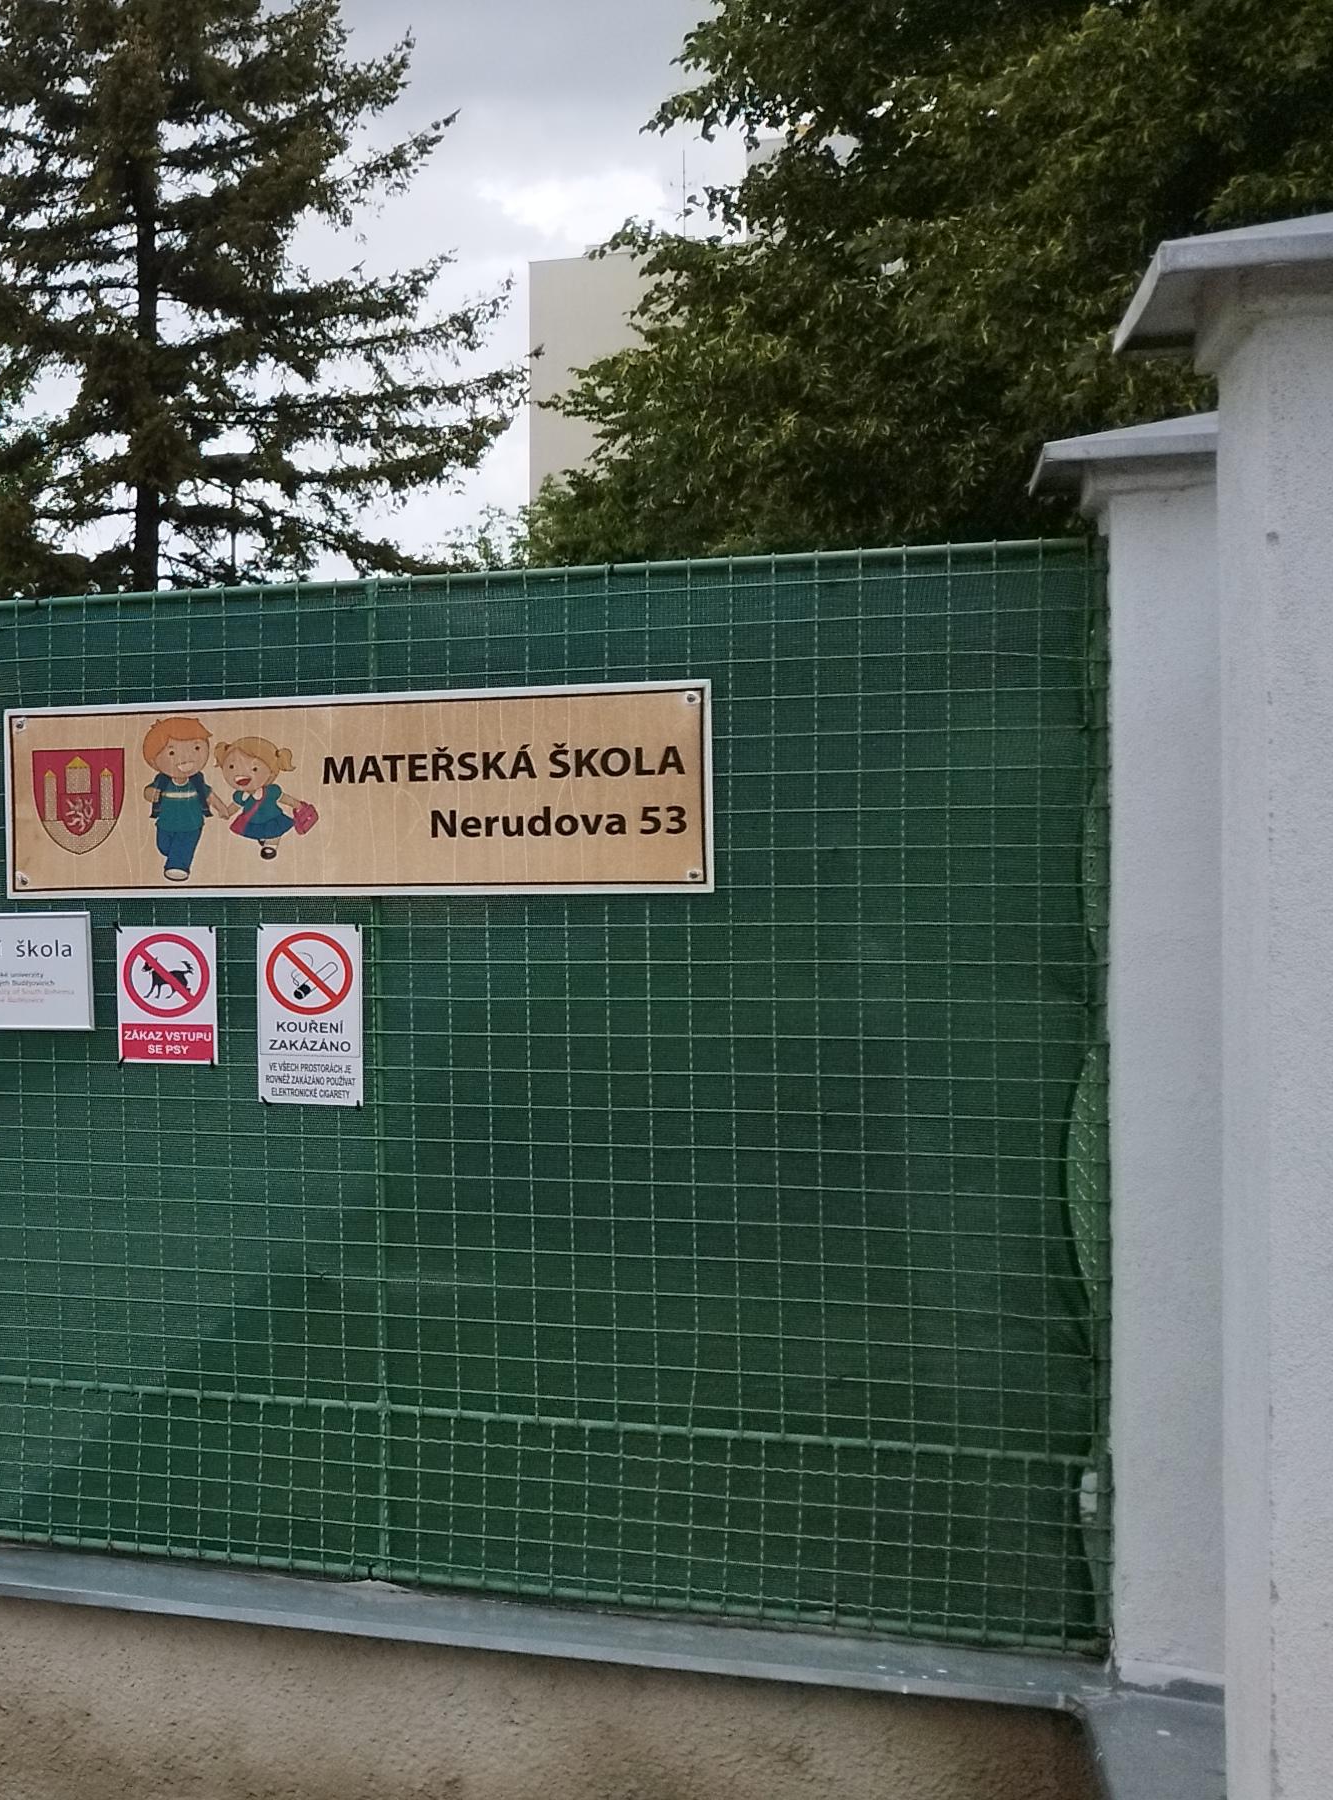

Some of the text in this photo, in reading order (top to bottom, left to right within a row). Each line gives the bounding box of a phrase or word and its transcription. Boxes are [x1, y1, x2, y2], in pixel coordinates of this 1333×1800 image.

[323, 743, 686, 784] MATEŘSKÁ ŠKOLA
[431, 806, 687, 838] Nerudova 53
[15, 939, 72, 958] škola
[276, 1020, 343, 1034] KOUŘENÍ
[124, 1028, 212, 1042] ZÁKAZ VSTUPU
[147, 1044, 189, 1054] SE PSY
[269, 1038, 351, 1052] ZAKÁZÁNO
[269, 1061, 352, 1074] VE VŠECH PROSTORÁCH JE
[265, 1074, 290, 1084] ROVNĚŽ
[292, 1075, 324, 1086] ZAKÁZÁNO
[271, 1087, 350, 1099] ELEKTRONICKÉ CIGARETY
